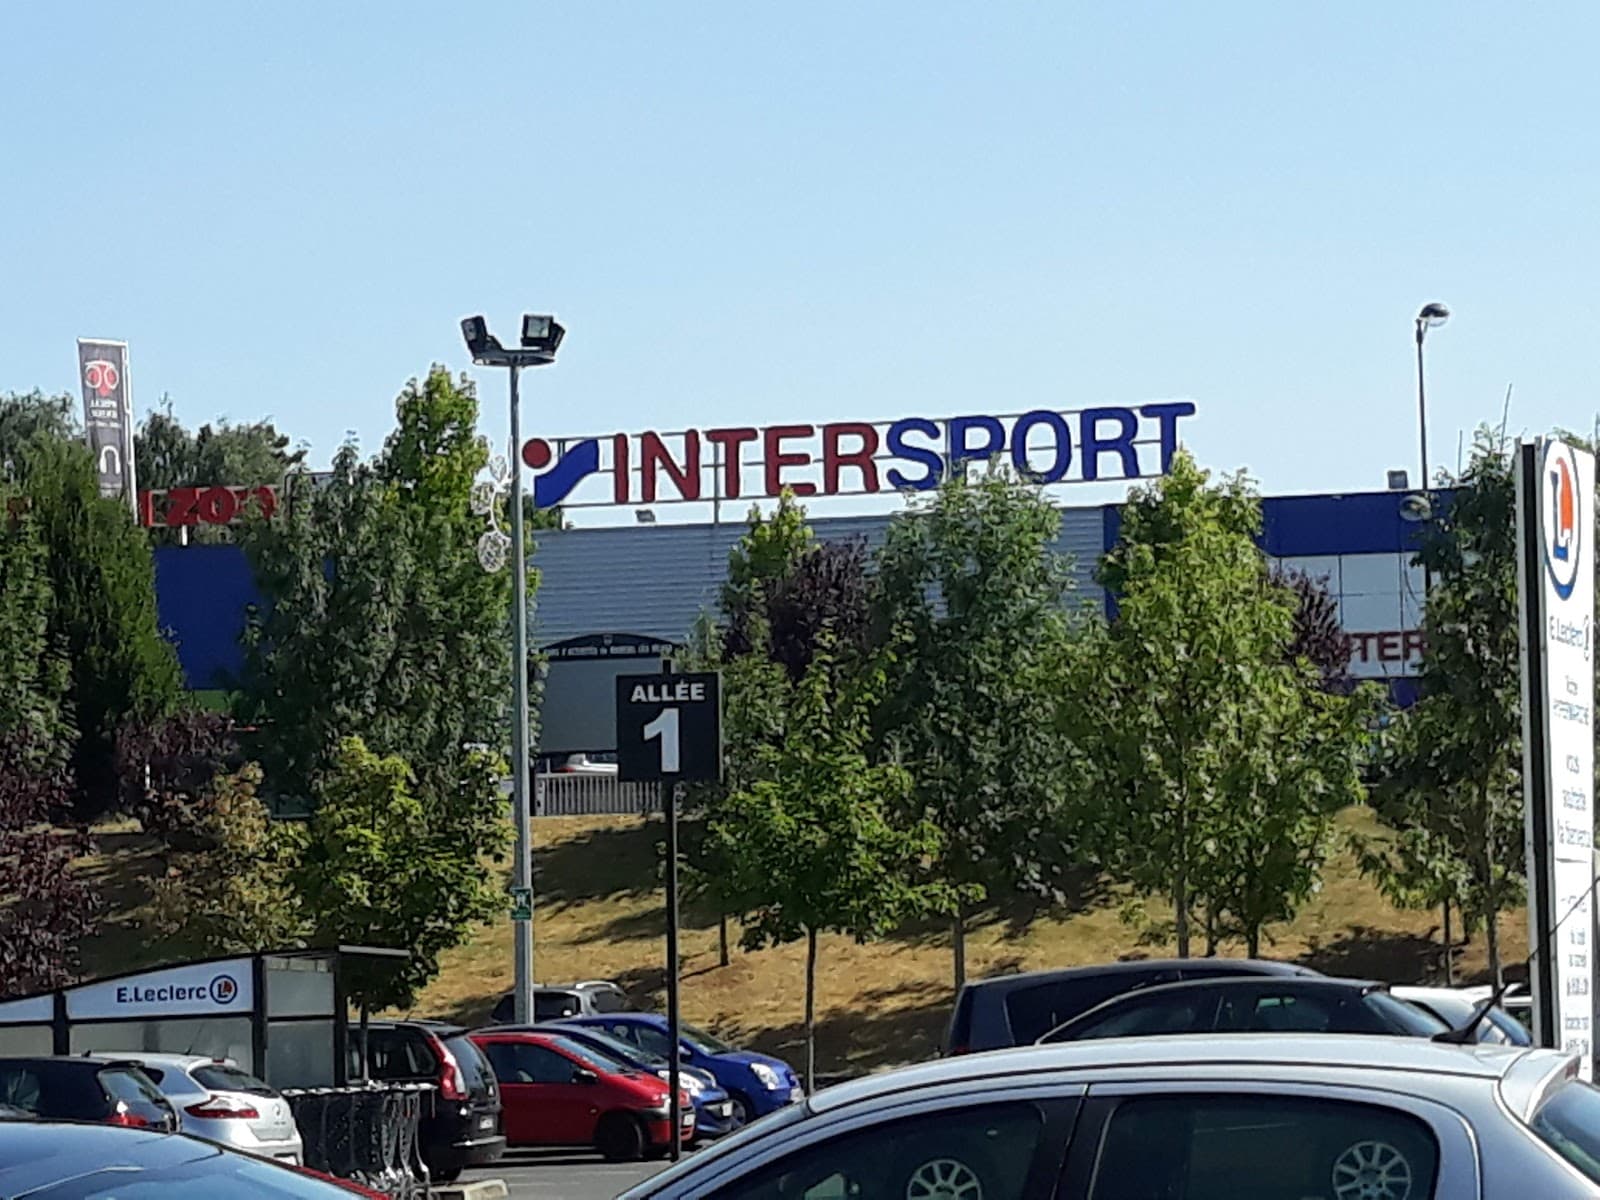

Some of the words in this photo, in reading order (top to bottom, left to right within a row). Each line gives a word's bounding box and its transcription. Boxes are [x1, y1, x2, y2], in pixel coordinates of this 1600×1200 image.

[613, 402, 1196, 504] INTERSPORT
[631, 679, 706, 702] ALLÉE
[643, 707, 680, 772] 1
[116, 984, 207, 1003] E.Leclerc
